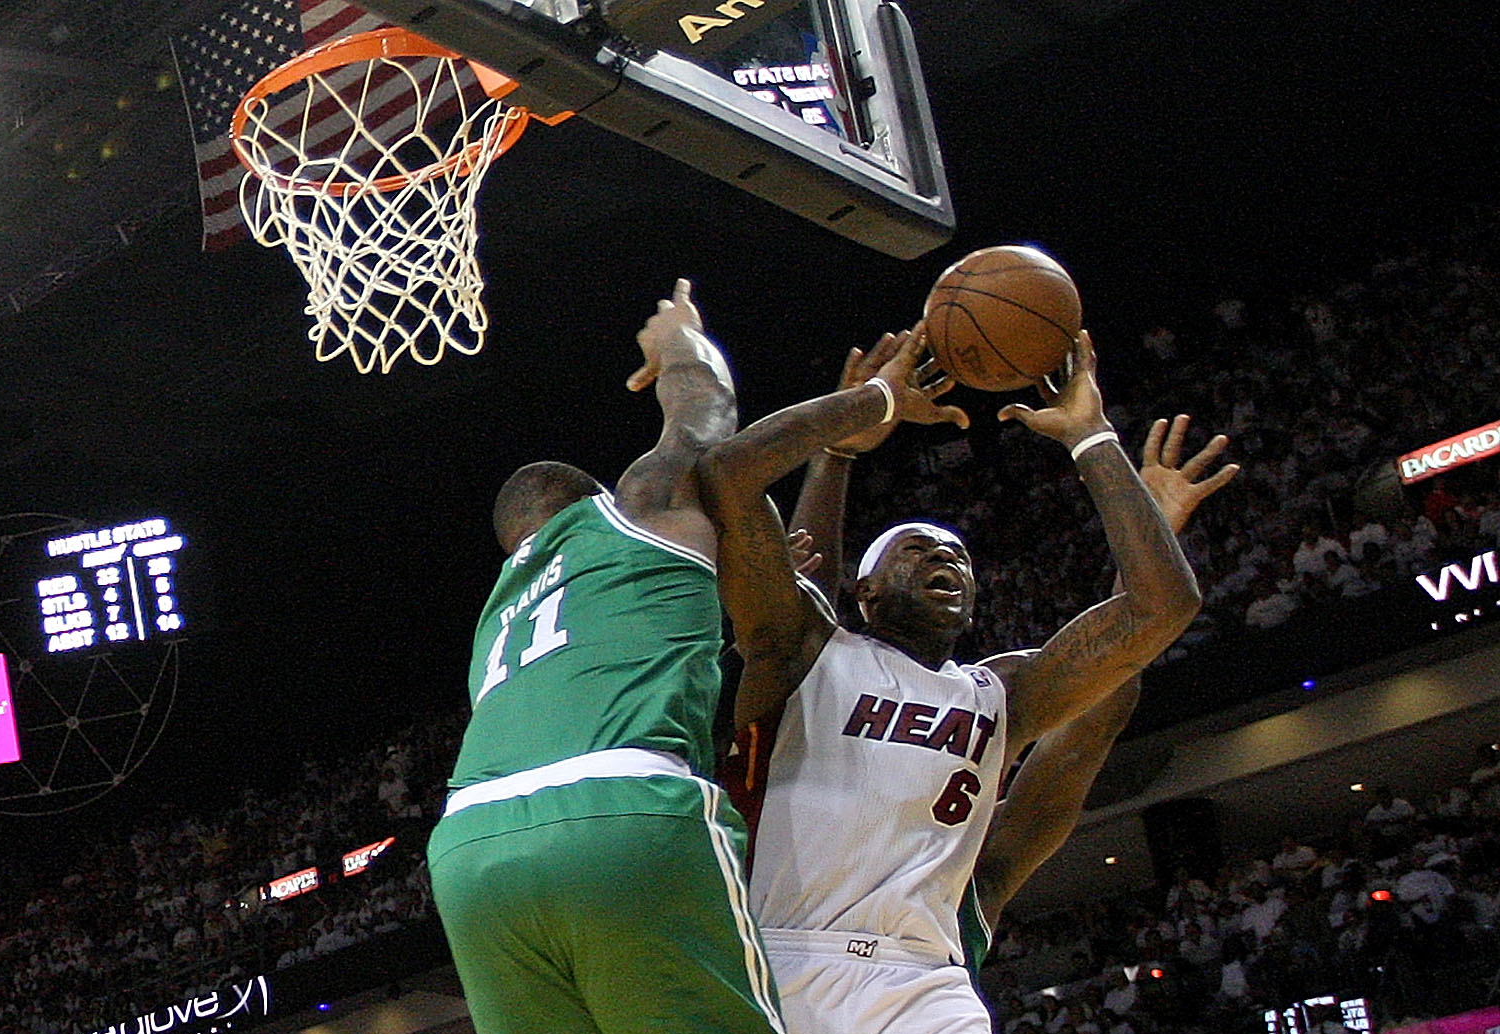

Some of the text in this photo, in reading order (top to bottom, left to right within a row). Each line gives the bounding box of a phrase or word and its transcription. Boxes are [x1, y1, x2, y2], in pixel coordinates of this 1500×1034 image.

[1402, 425, 1500, 478] BACARD
[48, 529, 113, 557] HUSTLE
[112, 519, 167, 544] STATS
[106, 605, 120, 622] 7
[500, 554, 564, 628] DAVIS
[476, 586, 569, 703] 11
[842, 692, 1000, 765] HEAT
[931, 768, 982, 826] 6
